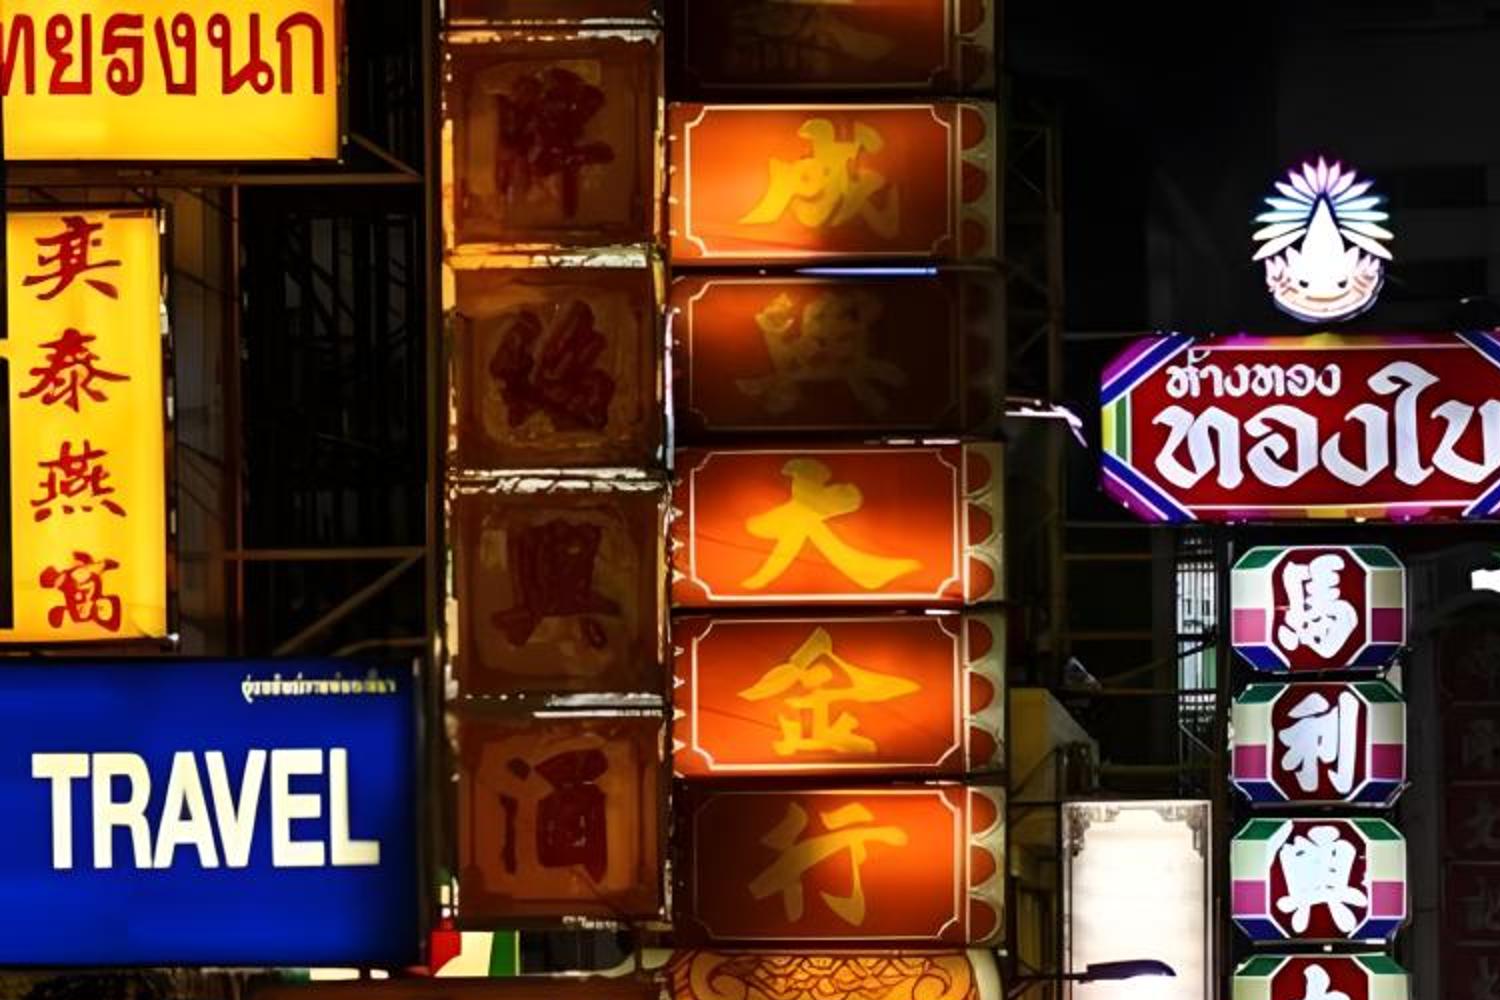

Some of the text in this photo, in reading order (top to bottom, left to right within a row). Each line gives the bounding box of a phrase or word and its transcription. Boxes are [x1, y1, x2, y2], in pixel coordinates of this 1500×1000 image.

[1166, 350, 1341, 398] ห้างทอง
[31, 748, 380, 870] TRAVEL
